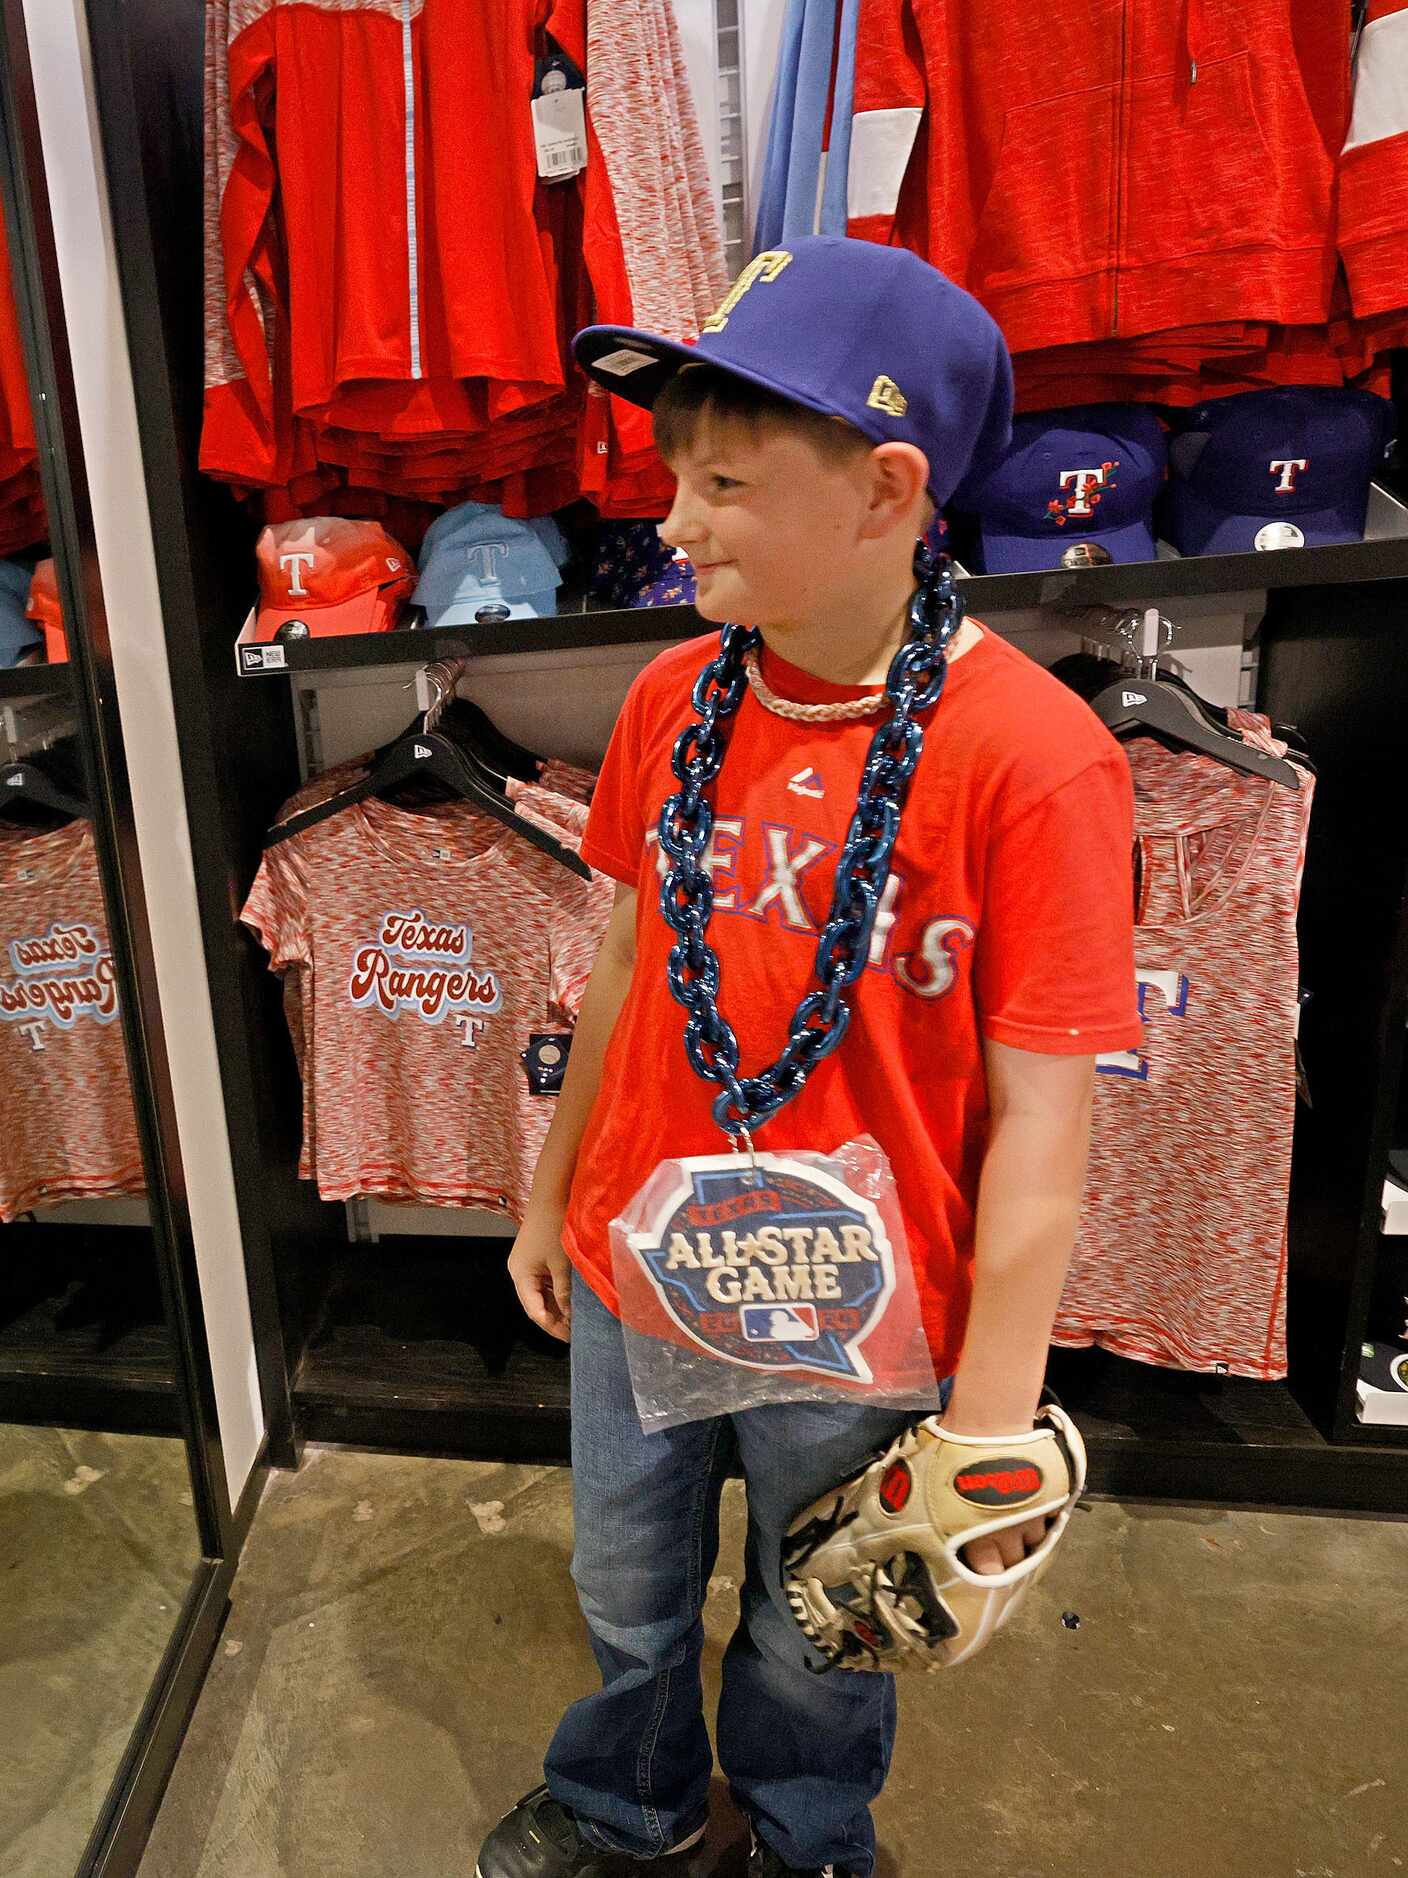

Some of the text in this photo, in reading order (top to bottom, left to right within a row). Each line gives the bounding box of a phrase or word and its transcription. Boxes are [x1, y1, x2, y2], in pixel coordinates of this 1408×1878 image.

[1059, 468, 1105, 518] T
[1268, 458, 1309, 494] T
[279, 552, 315, 597] T
[467, 542, 510, 586] T
[381, 911, 466, 955] Texas
[351, 947, 497, 1016] Rangers
[455, 1015, 484, 1048] T
[706, 1264, 842, 1304] GAME
